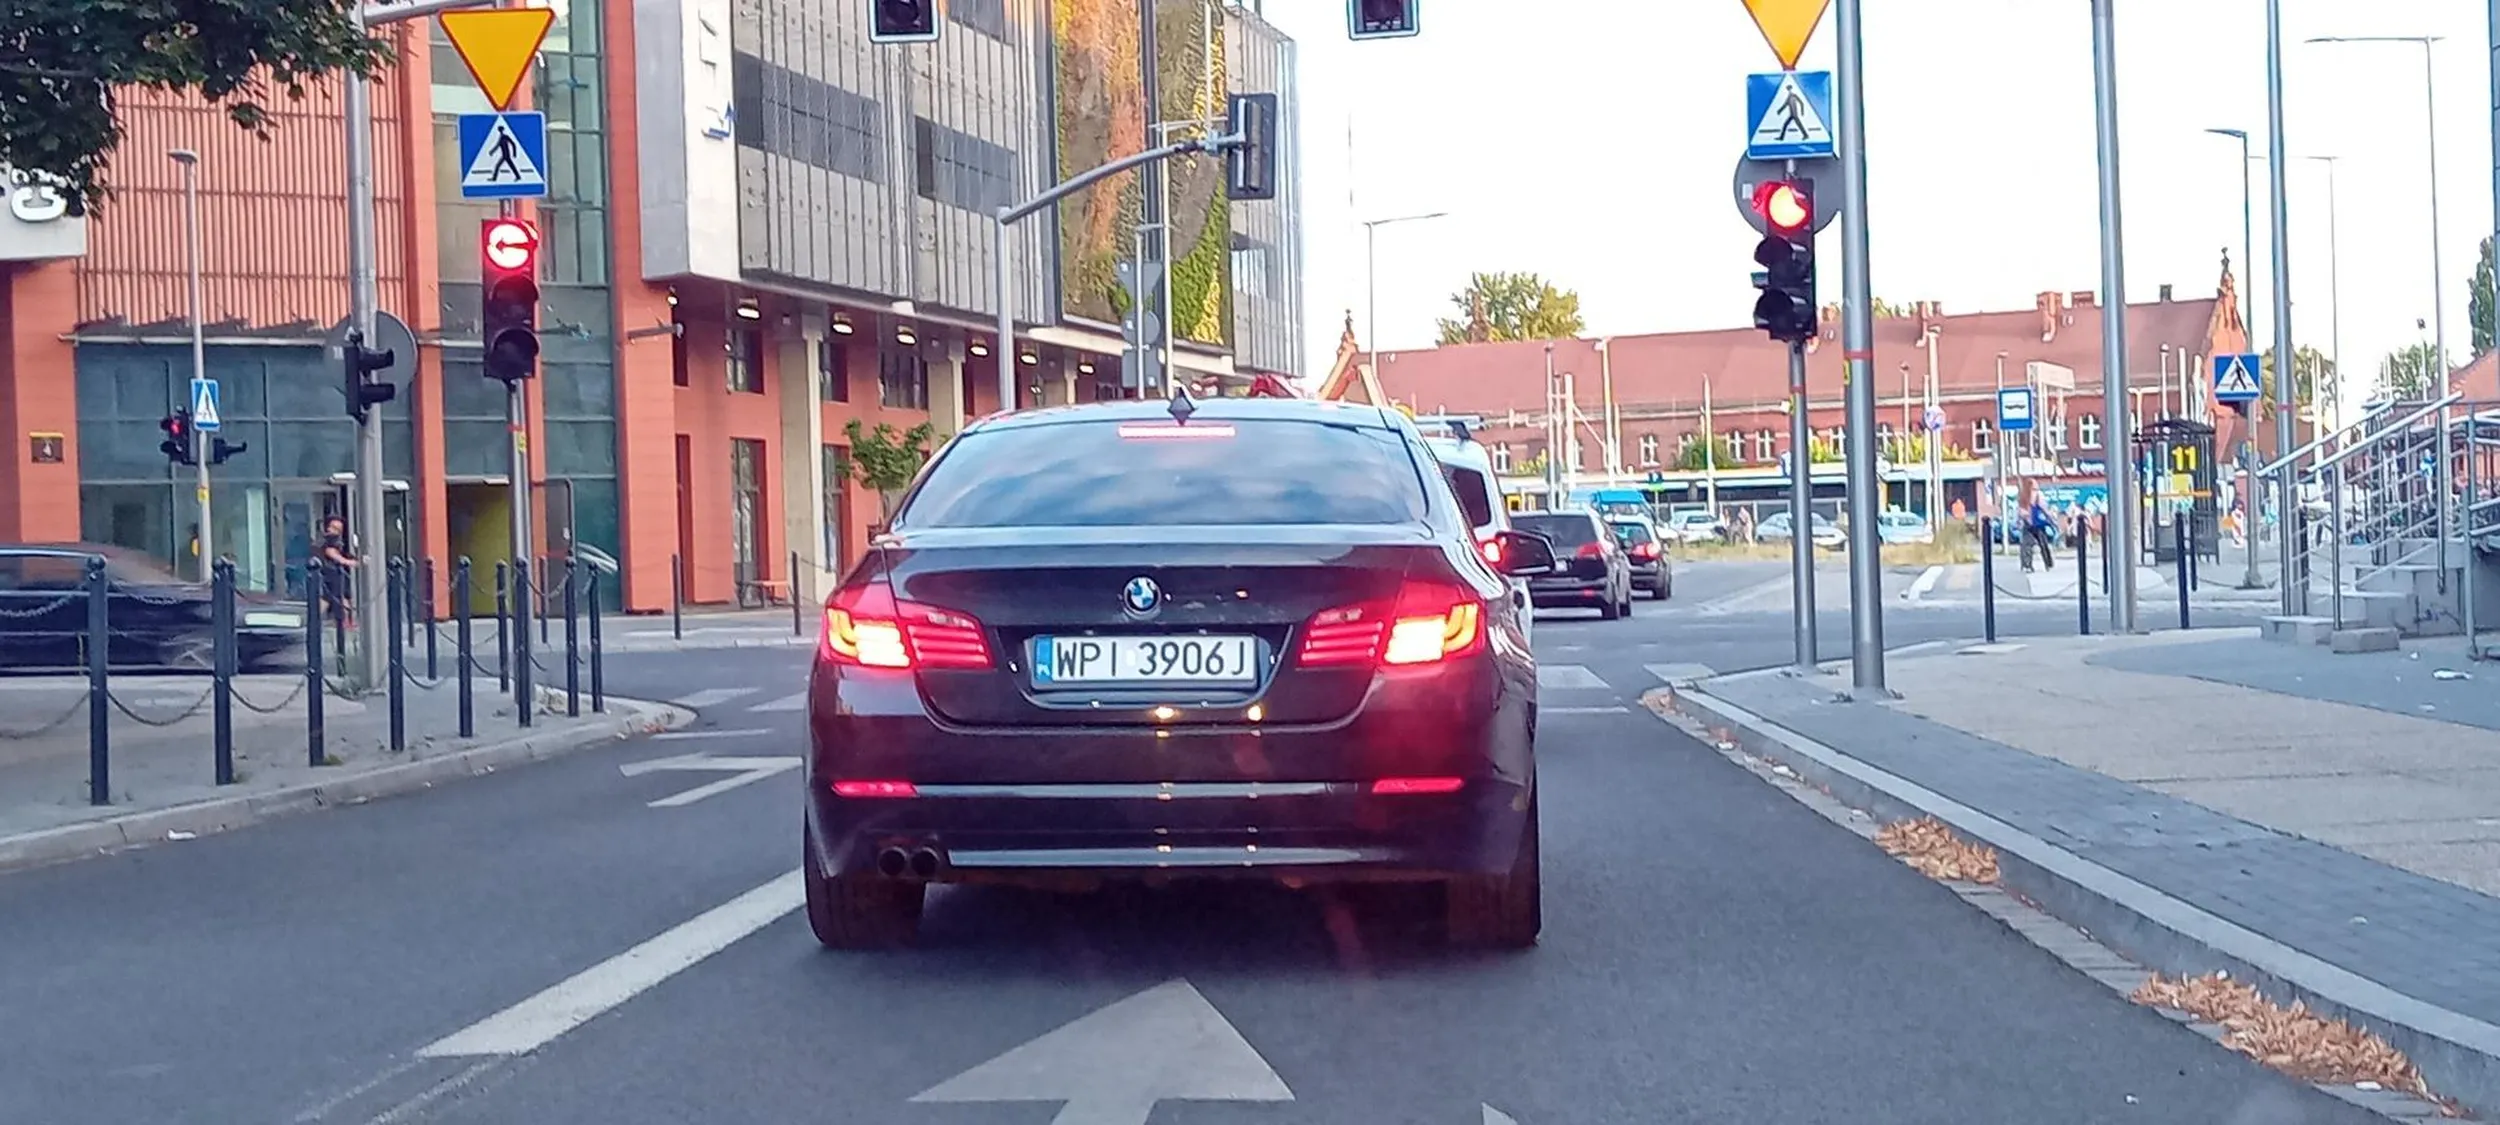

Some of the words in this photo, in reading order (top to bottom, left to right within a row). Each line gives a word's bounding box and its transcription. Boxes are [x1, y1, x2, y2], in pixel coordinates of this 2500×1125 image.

[2172, 446, 2196, 471] 11
[1056, 641, 1117, 678] WPI
[1138, 641, 1245, 676] 3906J
